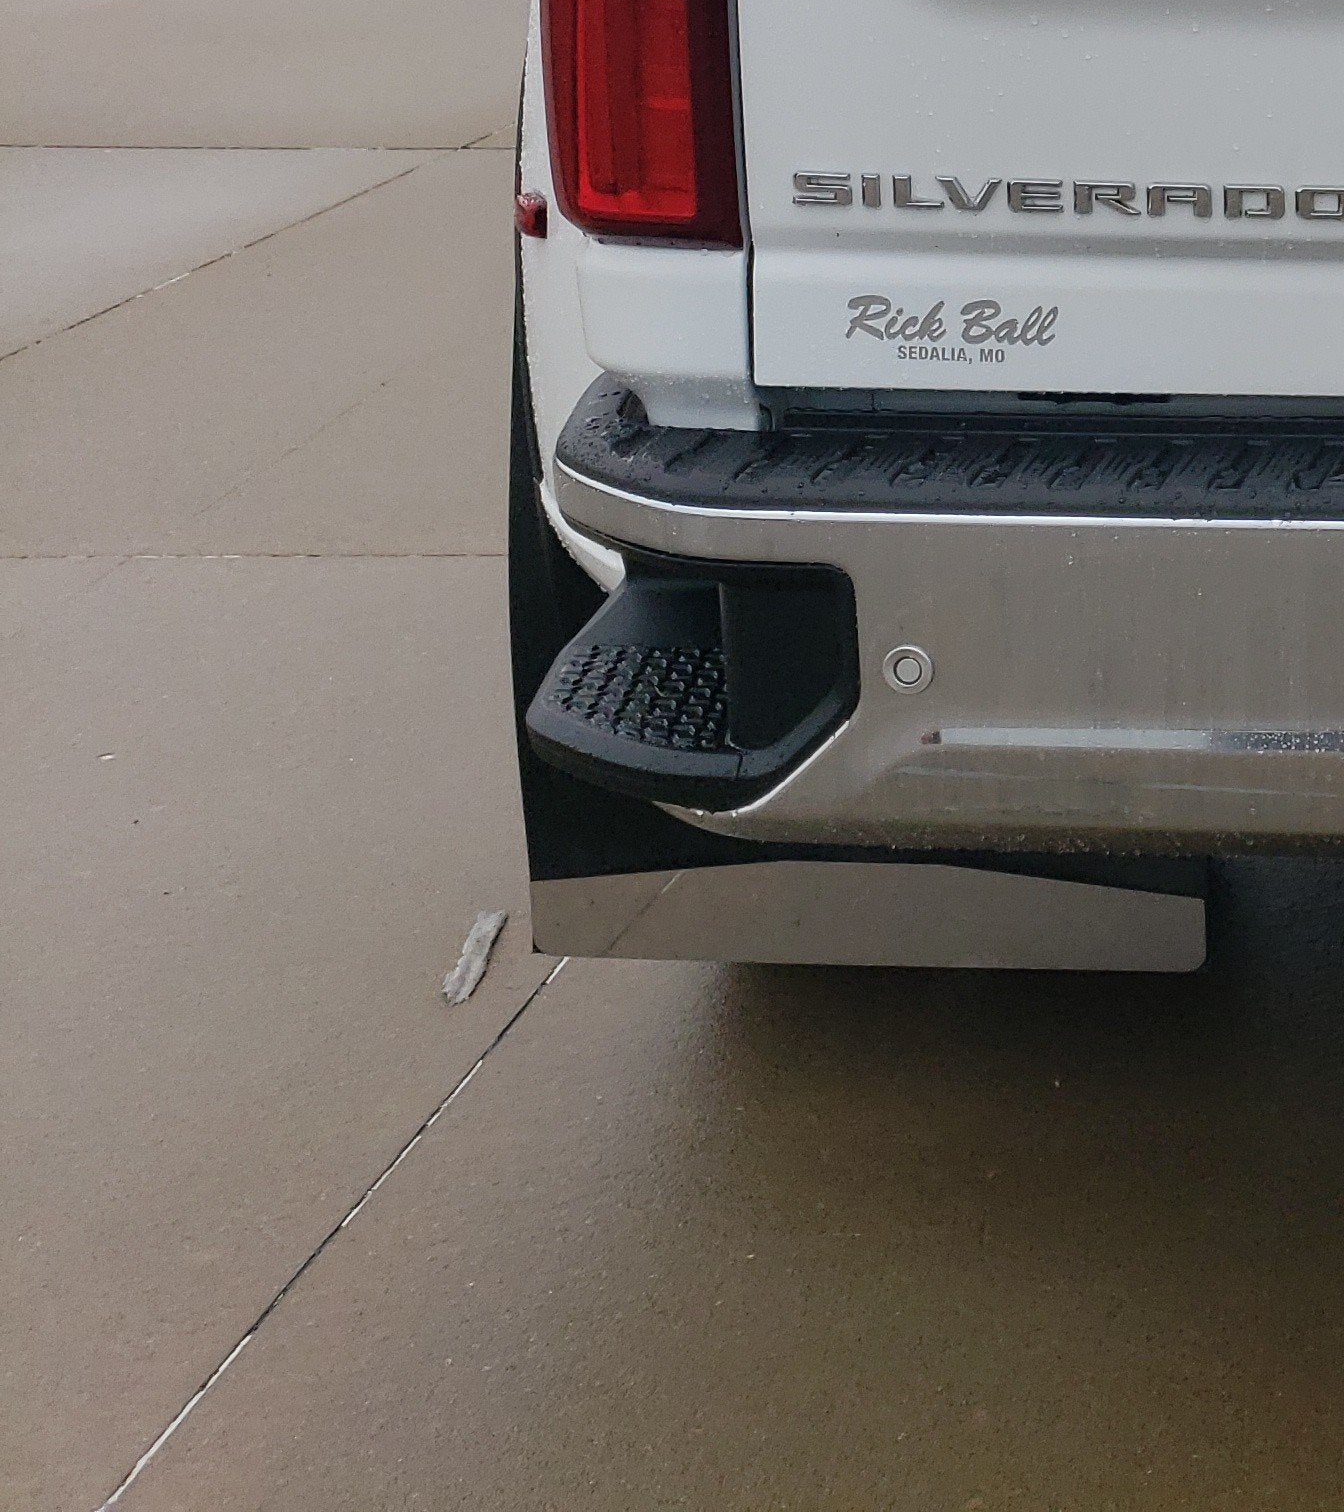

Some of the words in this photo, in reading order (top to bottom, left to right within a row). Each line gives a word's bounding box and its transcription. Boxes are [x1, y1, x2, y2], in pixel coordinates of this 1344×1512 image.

[845, 294, 948, 342] Rick
[960, 299, 1060, 347] Ball
[897, 344, 974, 365] SEDALIA,
[979, 347, 1006, 364] MO
